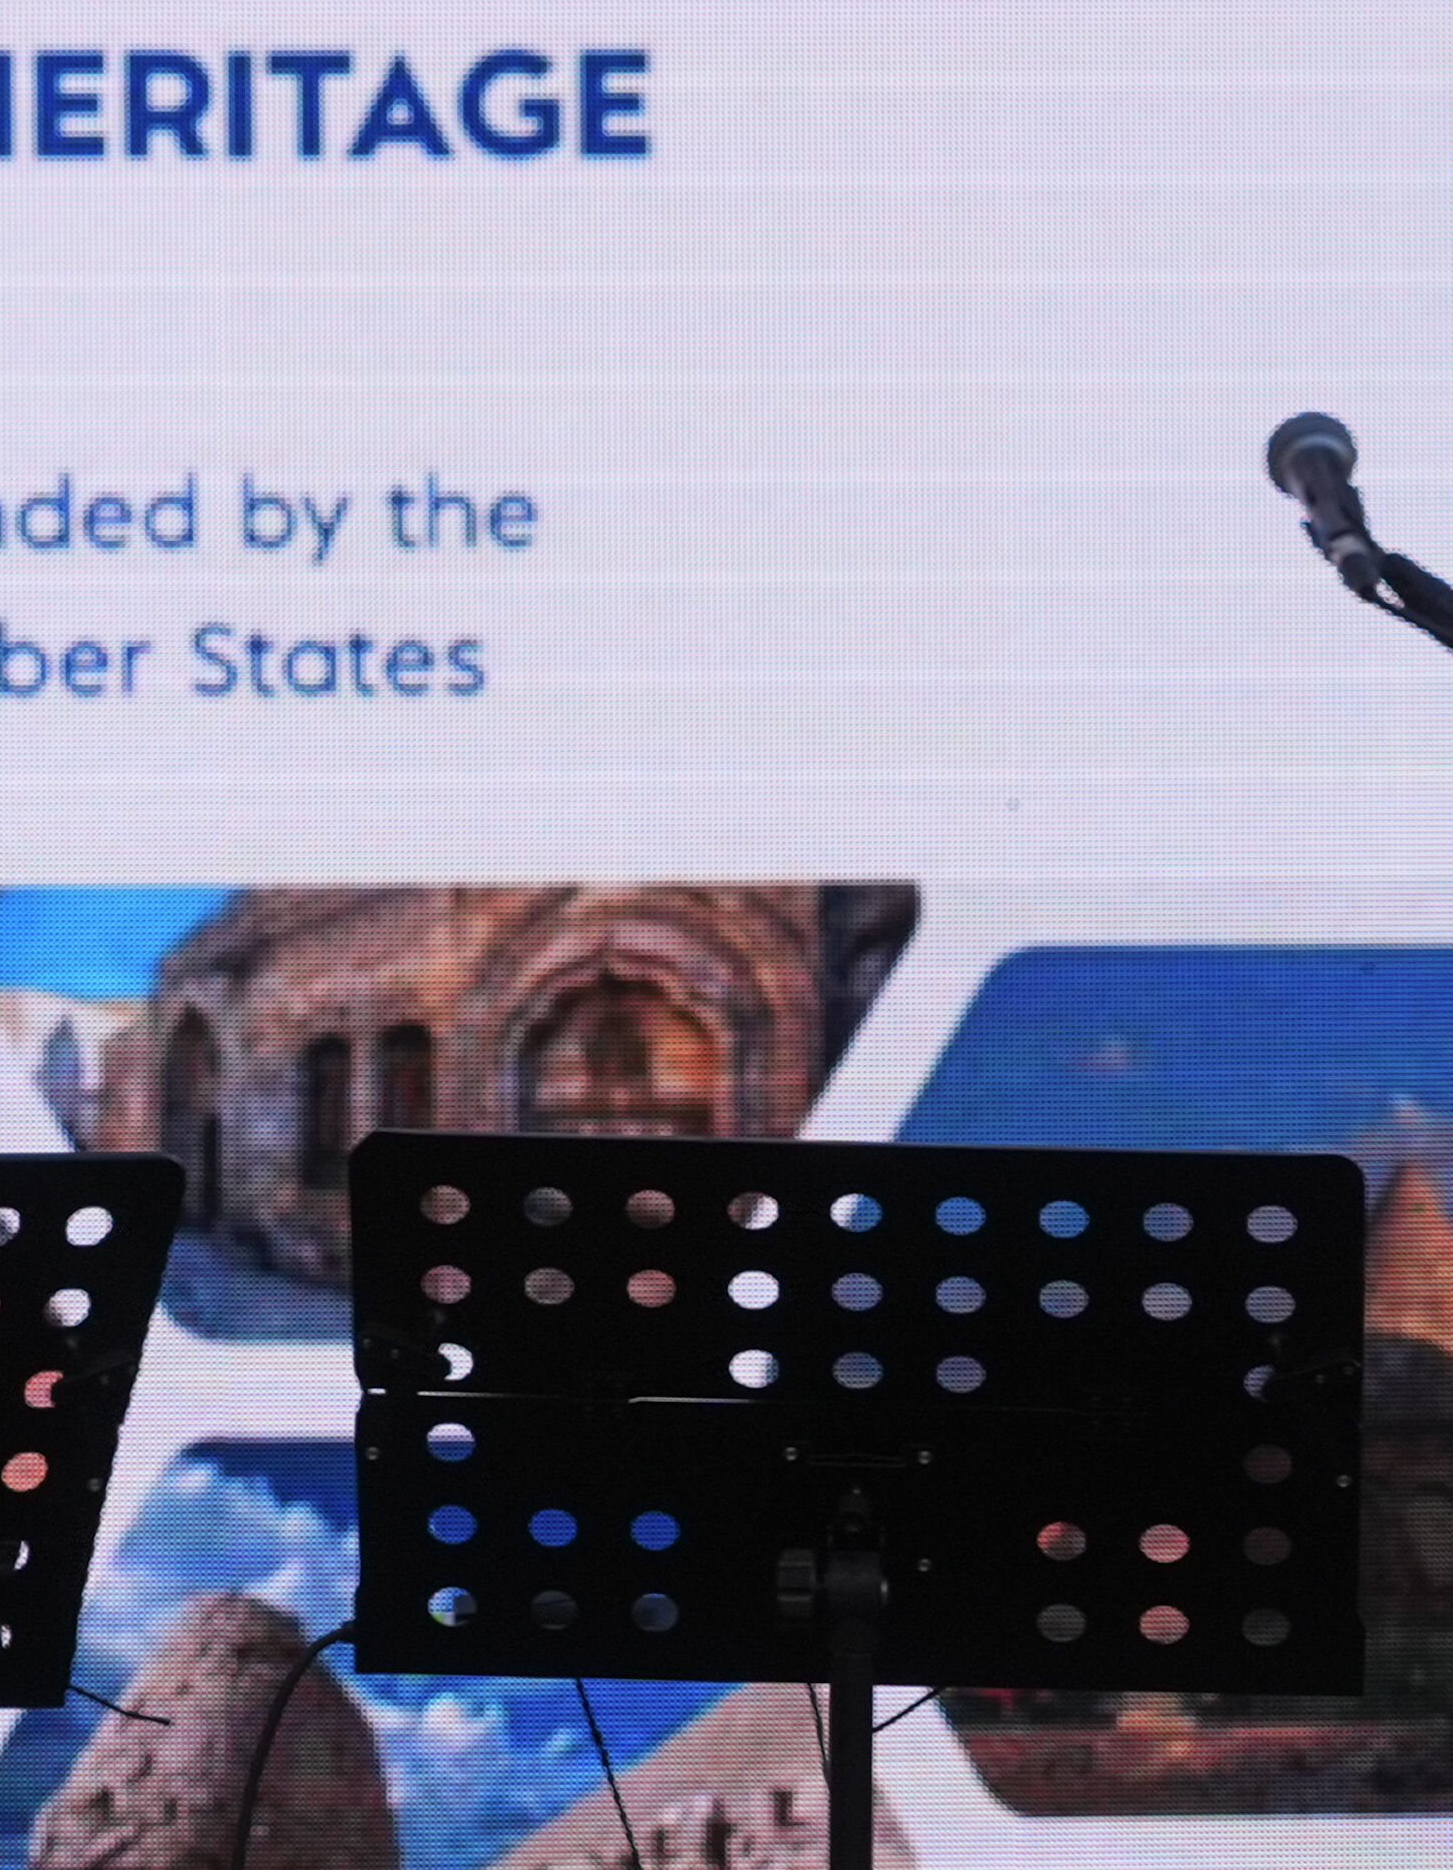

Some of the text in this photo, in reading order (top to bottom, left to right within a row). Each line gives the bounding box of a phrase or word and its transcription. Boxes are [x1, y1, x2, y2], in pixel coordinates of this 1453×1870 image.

[241, 474, 348, 568] by
[385, 473, 538, 553] the
[191, 622, 485, 702] States
